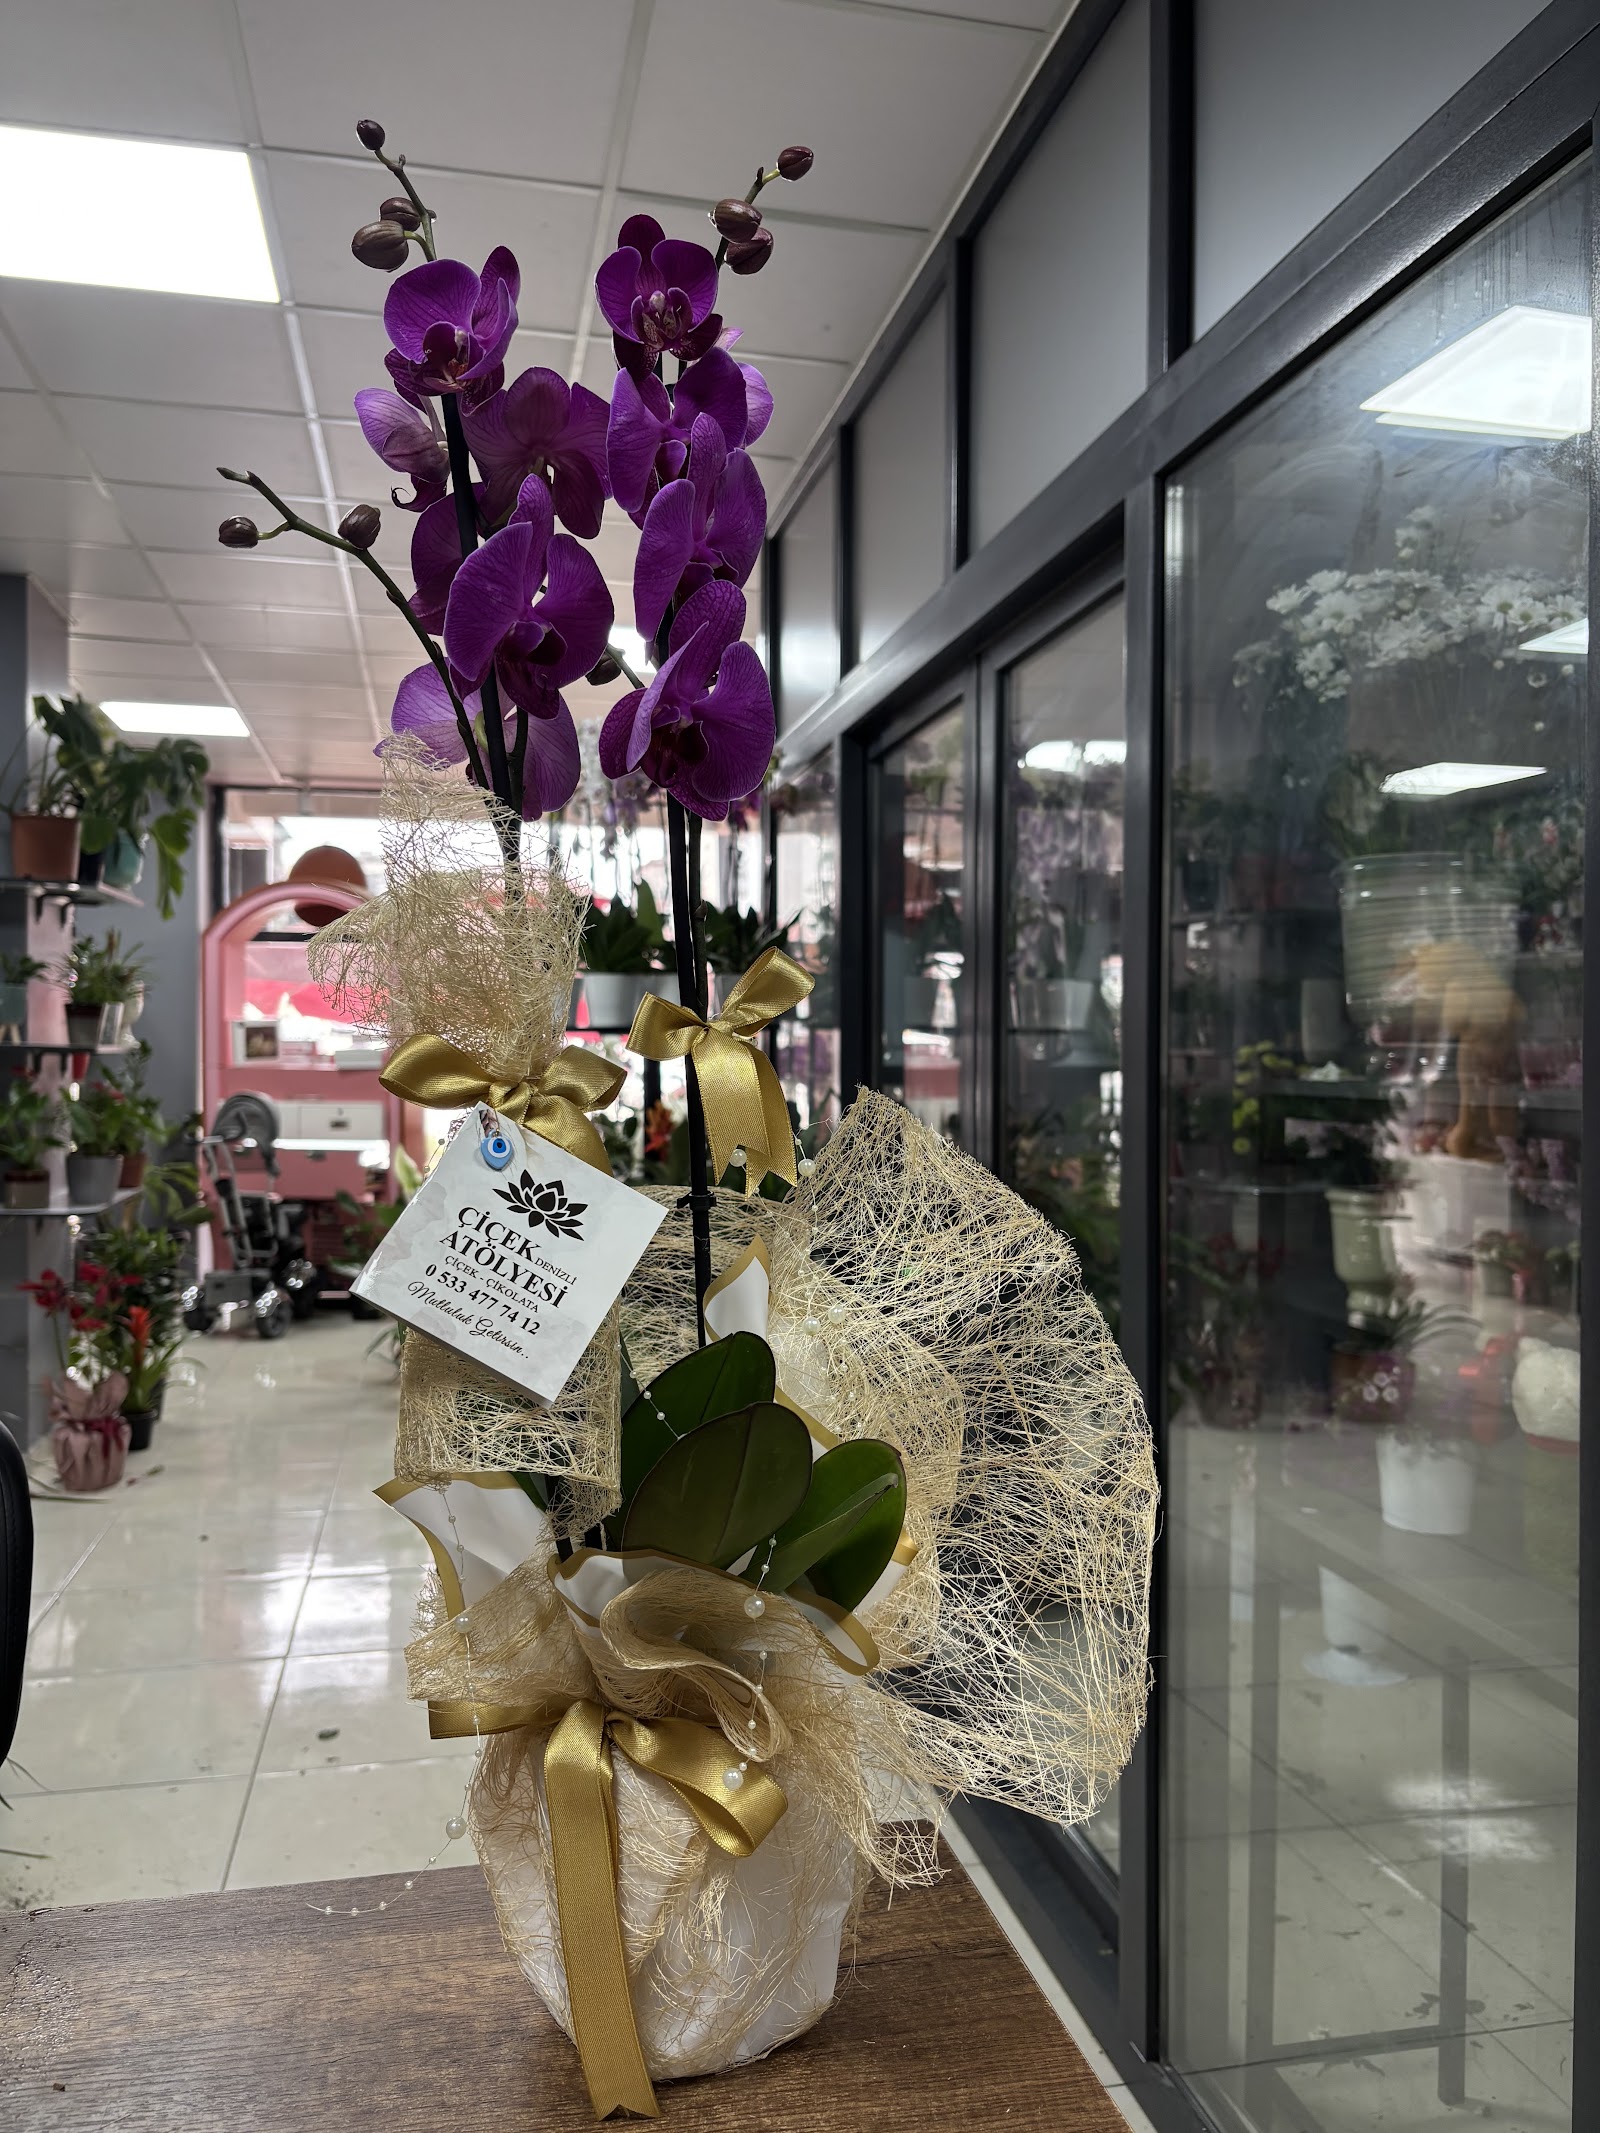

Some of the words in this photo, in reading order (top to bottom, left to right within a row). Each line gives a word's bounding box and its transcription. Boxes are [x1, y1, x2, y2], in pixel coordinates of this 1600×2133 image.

[458, 1206, 542, 1263] ÇİÇEK
[439, 1230, 568, 1309] ATÖLYESİ
[445, 1255, 479, 1279] ÇİÇEK
[486, 1278, 538, 1313] ÇİKOLATA
[534, 1257, 577, 1286] DENİZLİ
[425, 1263, 437, 1277] 0
[437, 1271, 467, 1293] 533
[468, 1289, 499, 1310] 477
[499, 1304, 519, 1323] 74
[519, 1317, 541, 1335] 12
